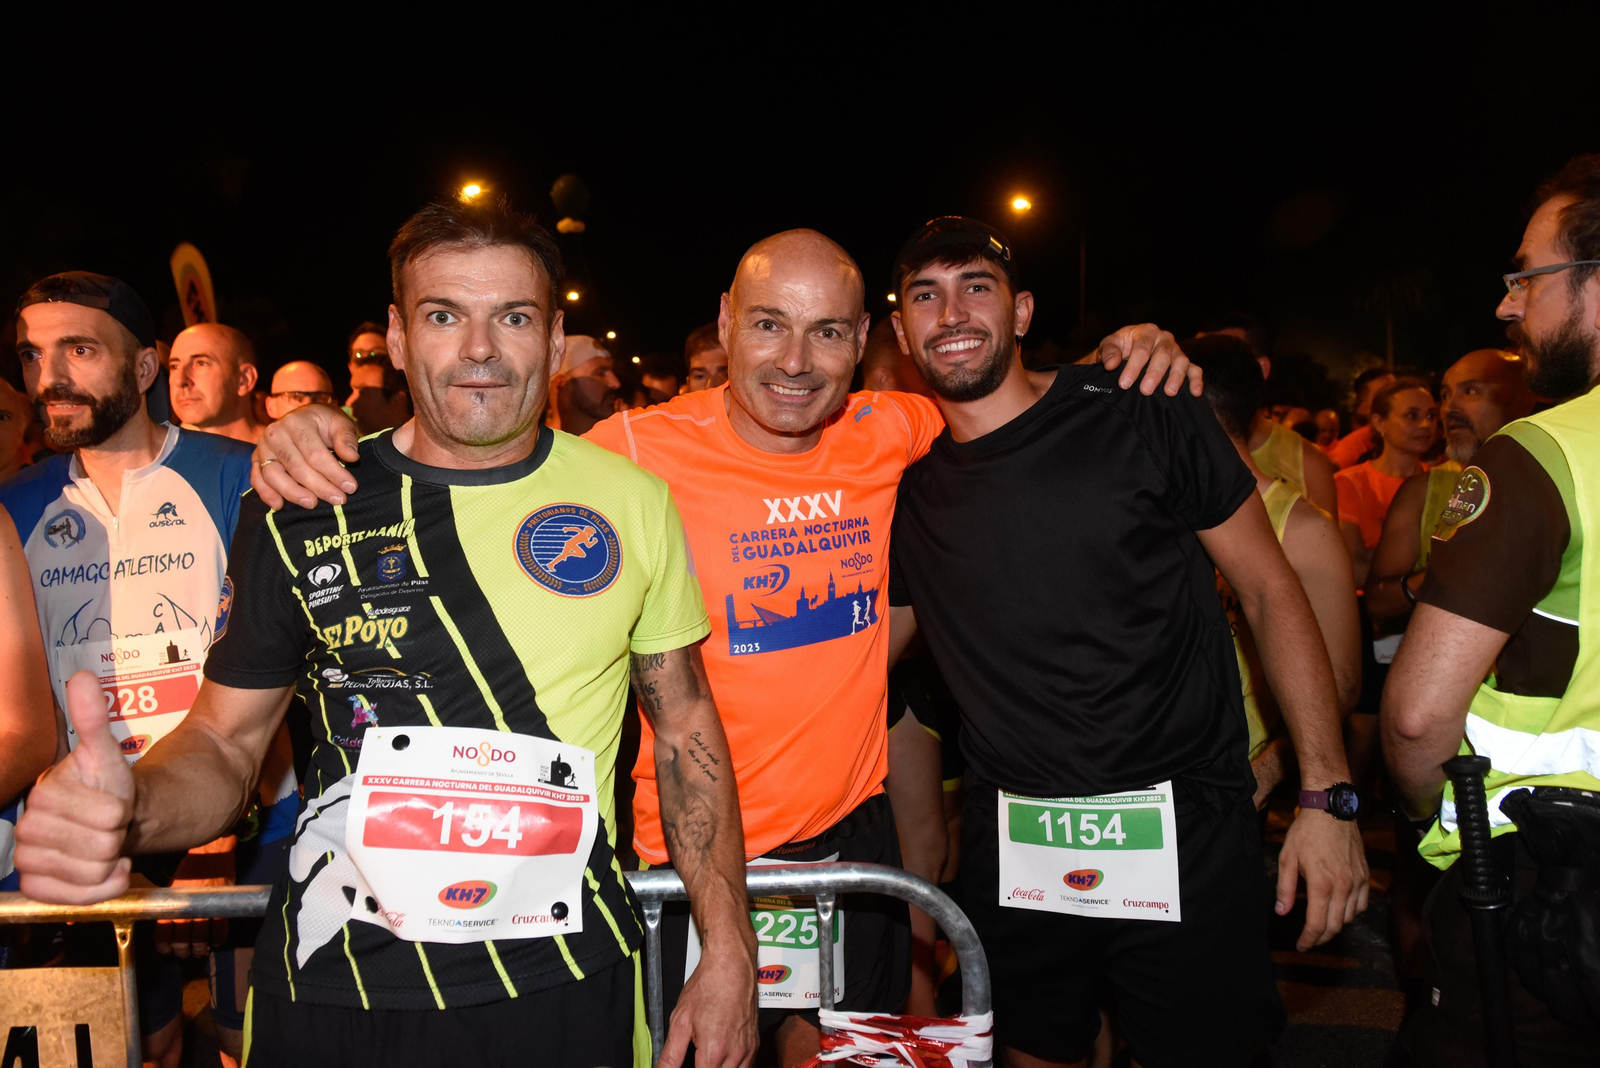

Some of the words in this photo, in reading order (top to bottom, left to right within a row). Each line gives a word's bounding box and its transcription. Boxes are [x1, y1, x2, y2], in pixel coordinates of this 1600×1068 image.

[579, 509, 588, 517] DE
[591, 514, 610, 533] PILAS
[763, 490, 842, 524] XXXV
[730, 527, 798, 544] CARRERA
[804, 516, 869, 536] NOCTURNA
[732, 545, 740, 563] DEL
[743, 530, 871, 561] GUADALQUIVIR
[114, 552, 194, 580] ATLETISMO
[367, 606, 411, 616] Autodesguace
[343, 617, 408, 649] Poyo
[734, 643, 760, 653] 2023
[131, 669, 171, 680] GUADALQUIVIR
[415, 680, 433, 688] S.L.
[368, 777, 391, 785] XXXV
[393, 778, 431, 787] CARRERA
[432, 780, 477, 791] NOCTURNA
[479, 783, 492, 791] DEL
[494, 785, 551, 797] GUADALQUIVIR
[551, 791, 566, 800] KH7
[566, 793, 584, 802] 2023
[432, 801, 522, 849] 154
[1038, 810, 1126, 846] 1154
[1123, 898, 1169, 910] Cruzcampo
[755, 912, 818, 945] 225
